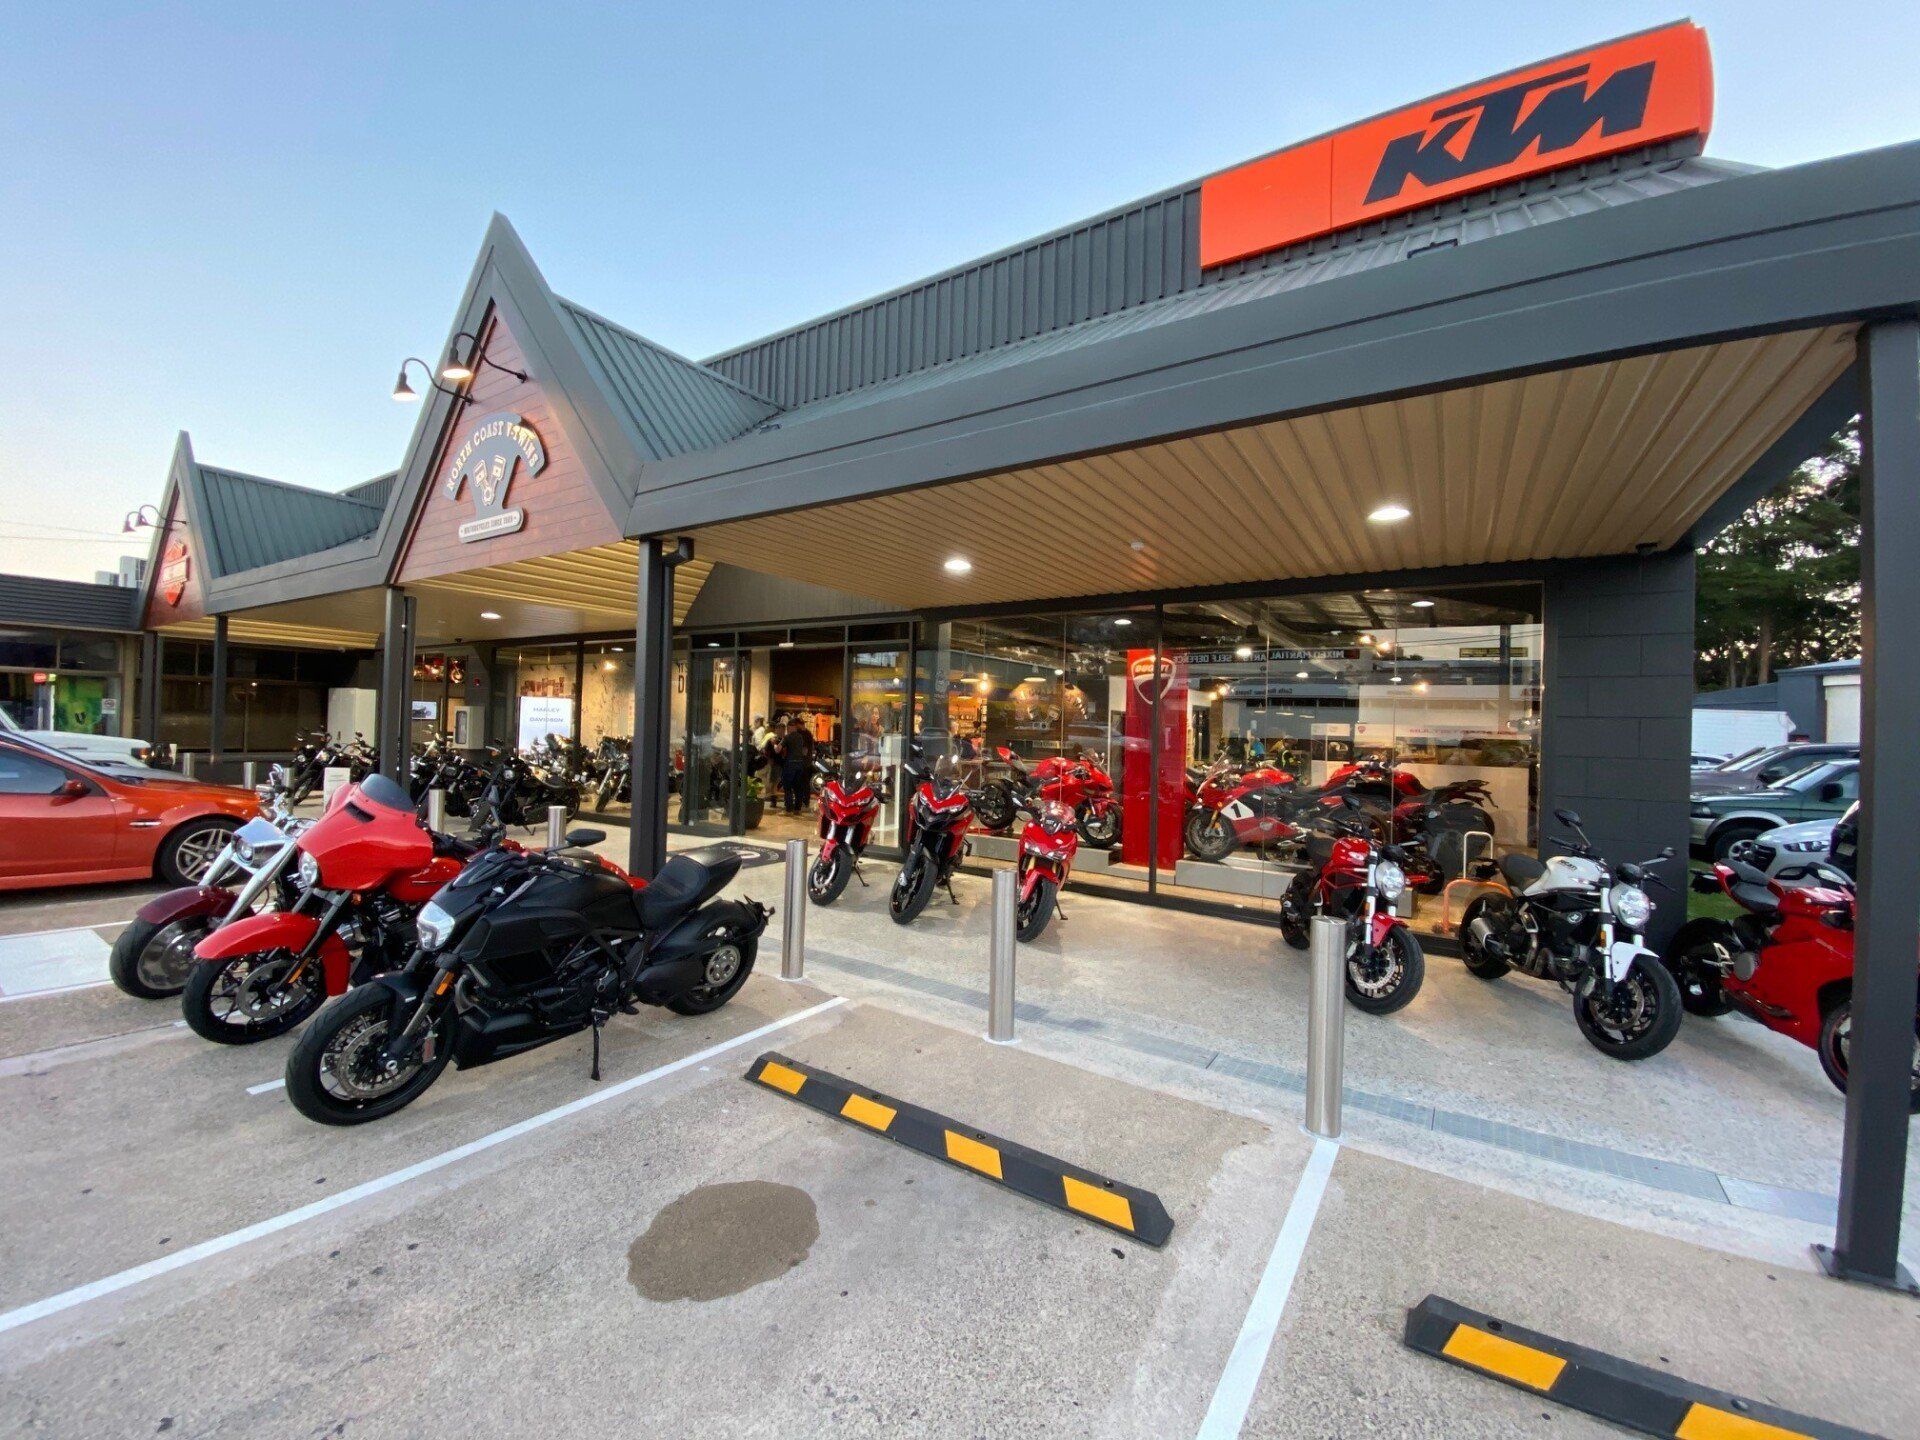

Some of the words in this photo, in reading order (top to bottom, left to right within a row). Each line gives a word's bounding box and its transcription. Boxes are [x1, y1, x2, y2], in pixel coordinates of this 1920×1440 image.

[1362, 61, 1656, 206] KTM
[446, 440, 473, 492] NORTH
[473, 420, 505, 447] COAST
[506, 422, 539, 468] V-TWINS
[1134, 663, 1170, 673] DUCTI
[1231, 803, 1242, 819] 1
